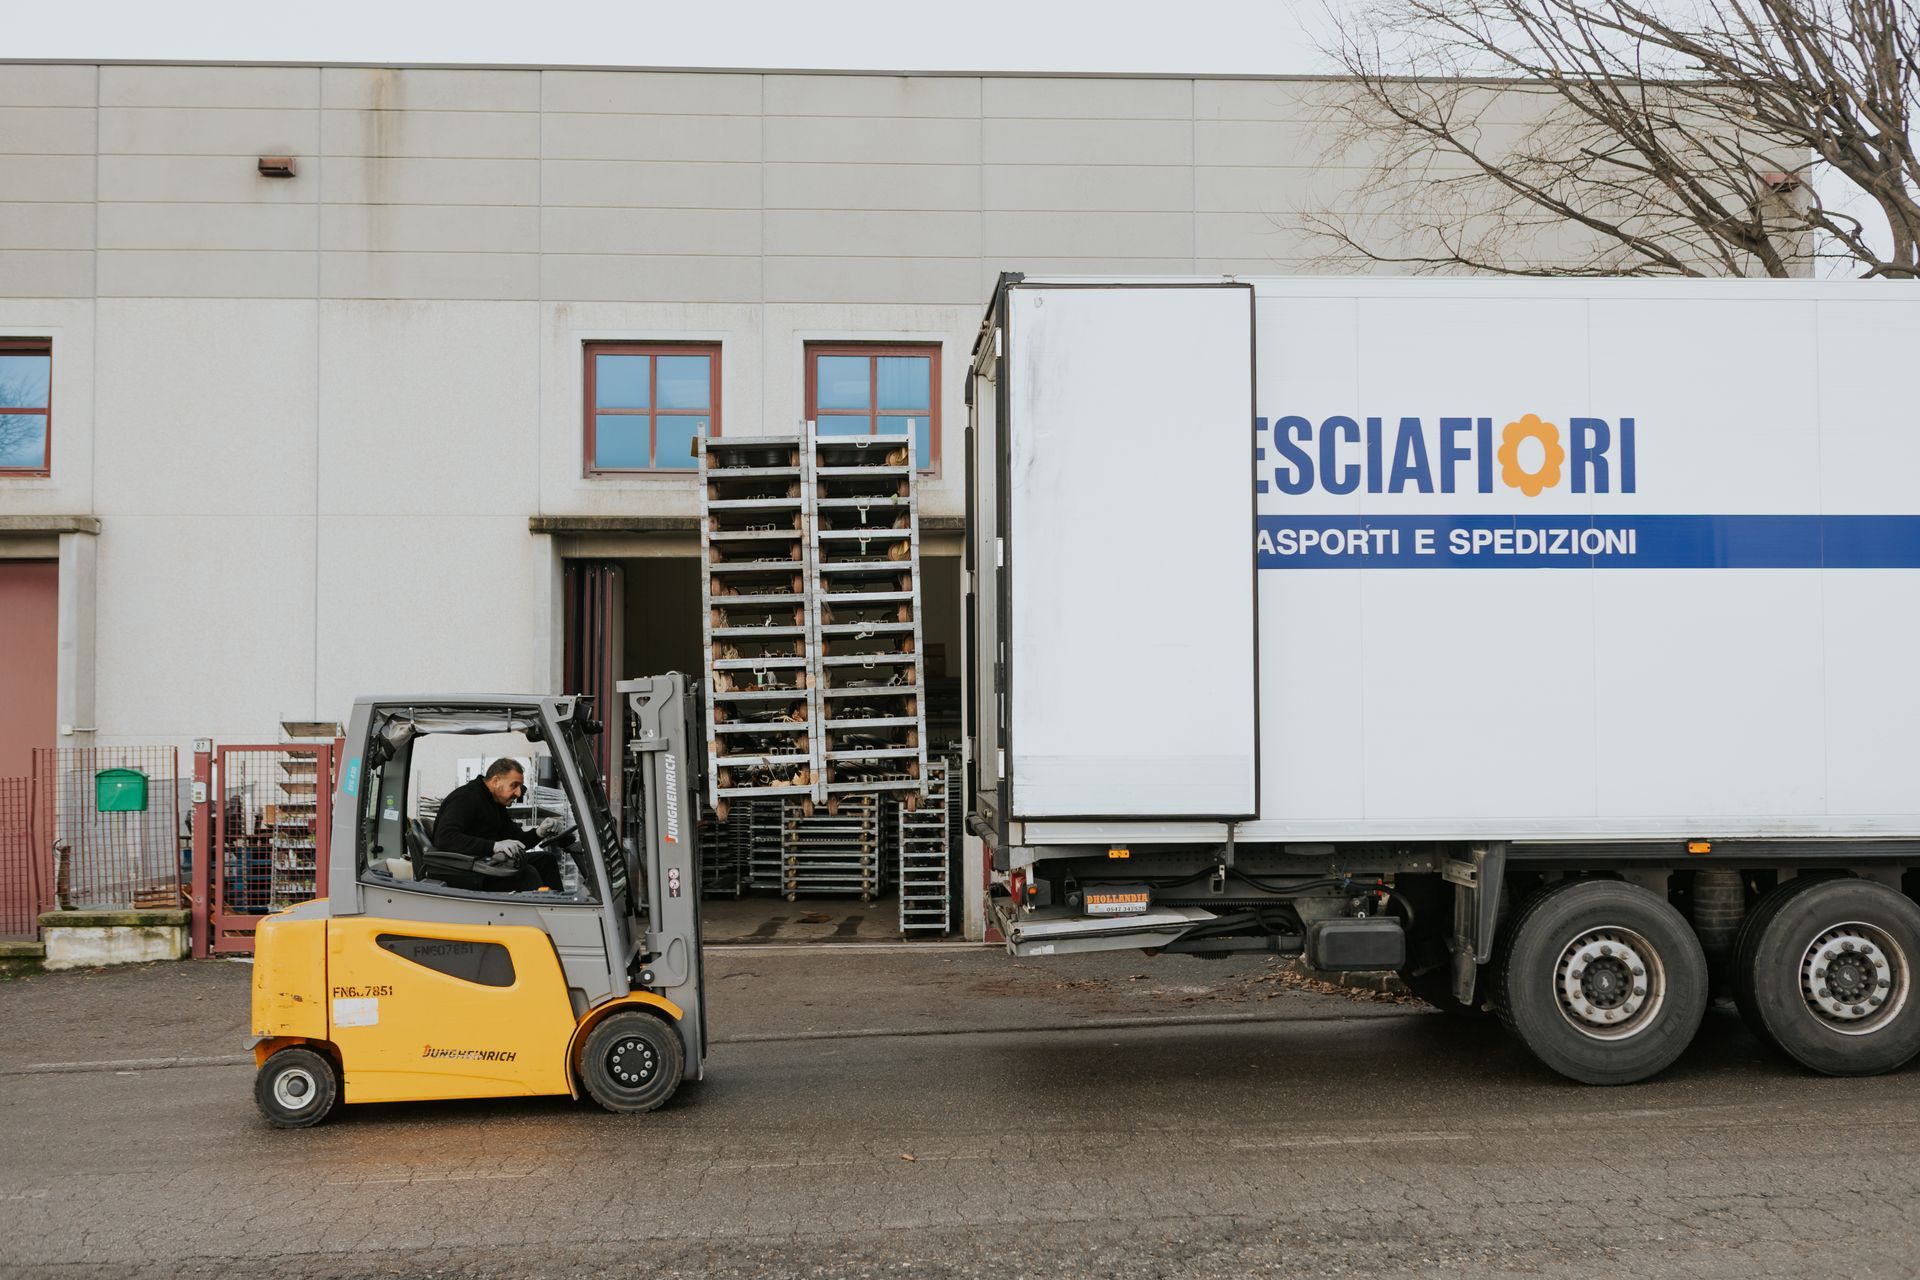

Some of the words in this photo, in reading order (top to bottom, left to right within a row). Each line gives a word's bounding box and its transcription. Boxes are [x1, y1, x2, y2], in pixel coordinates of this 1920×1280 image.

[1257, 529, 1399, 555] ASPORTI
[1415, 529, 1436, 555] E
[1449, 529, 1637, 555] SPEDIZIONI
[664, 753, 679, 844] JUNGHEINRICH
[1087, 893, 1148, 904] DHOLLANDIA
